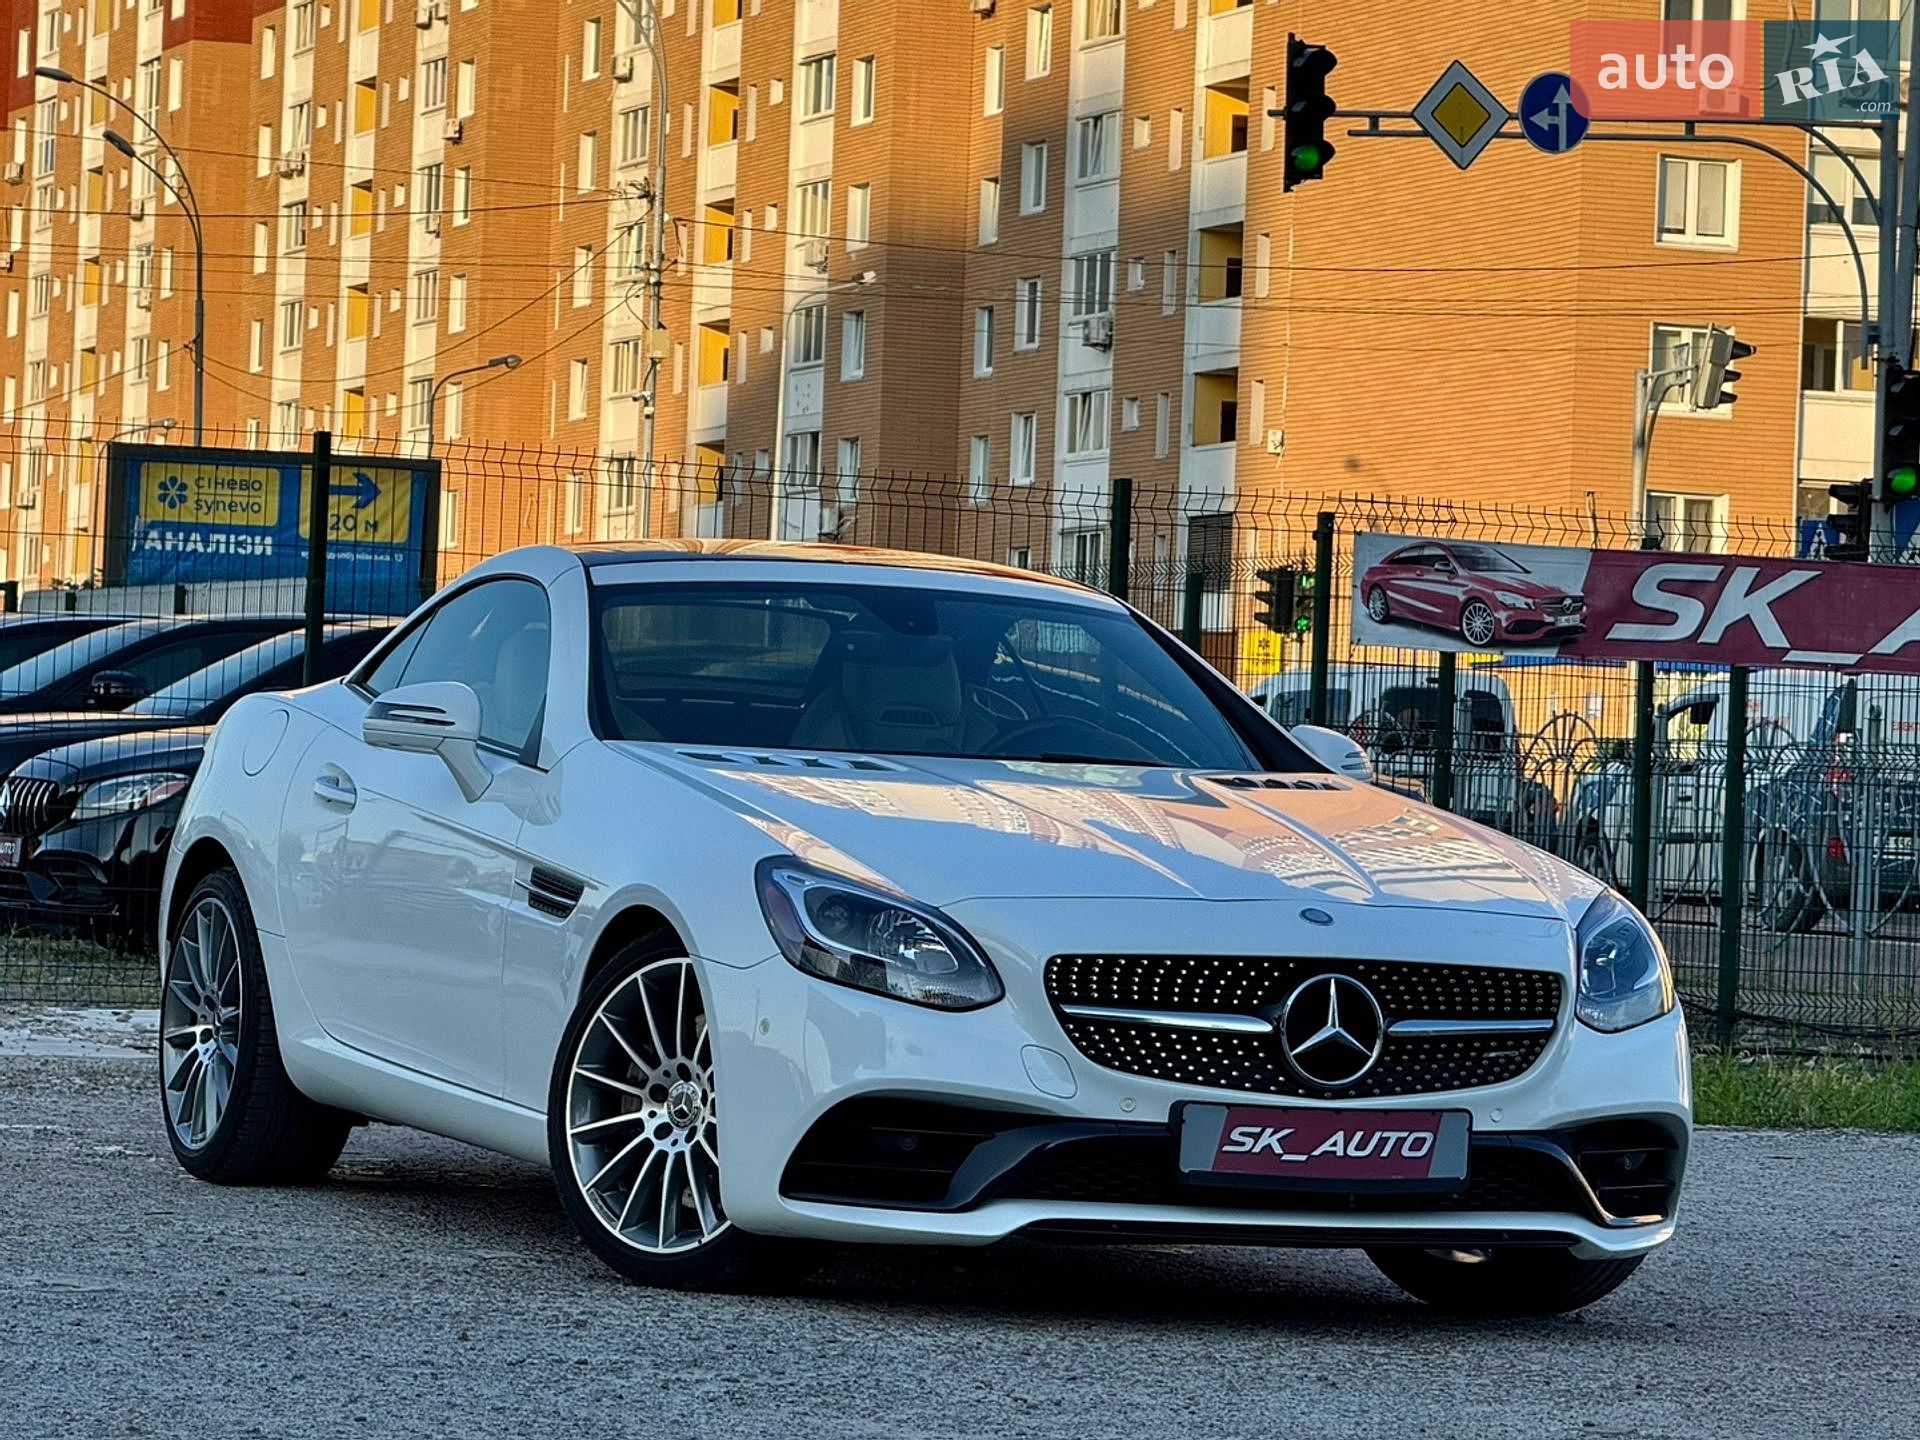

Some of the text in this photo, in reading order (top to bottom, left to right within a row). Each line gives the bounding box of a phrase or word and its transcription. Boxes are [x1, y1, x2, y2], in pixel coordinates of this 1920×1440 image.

[193, 498, 262, 515] synevo
[144, 530, 273, 556] АНАЛІЗИ
[1221, 1126, 1435, 1162] SK_AUTO
